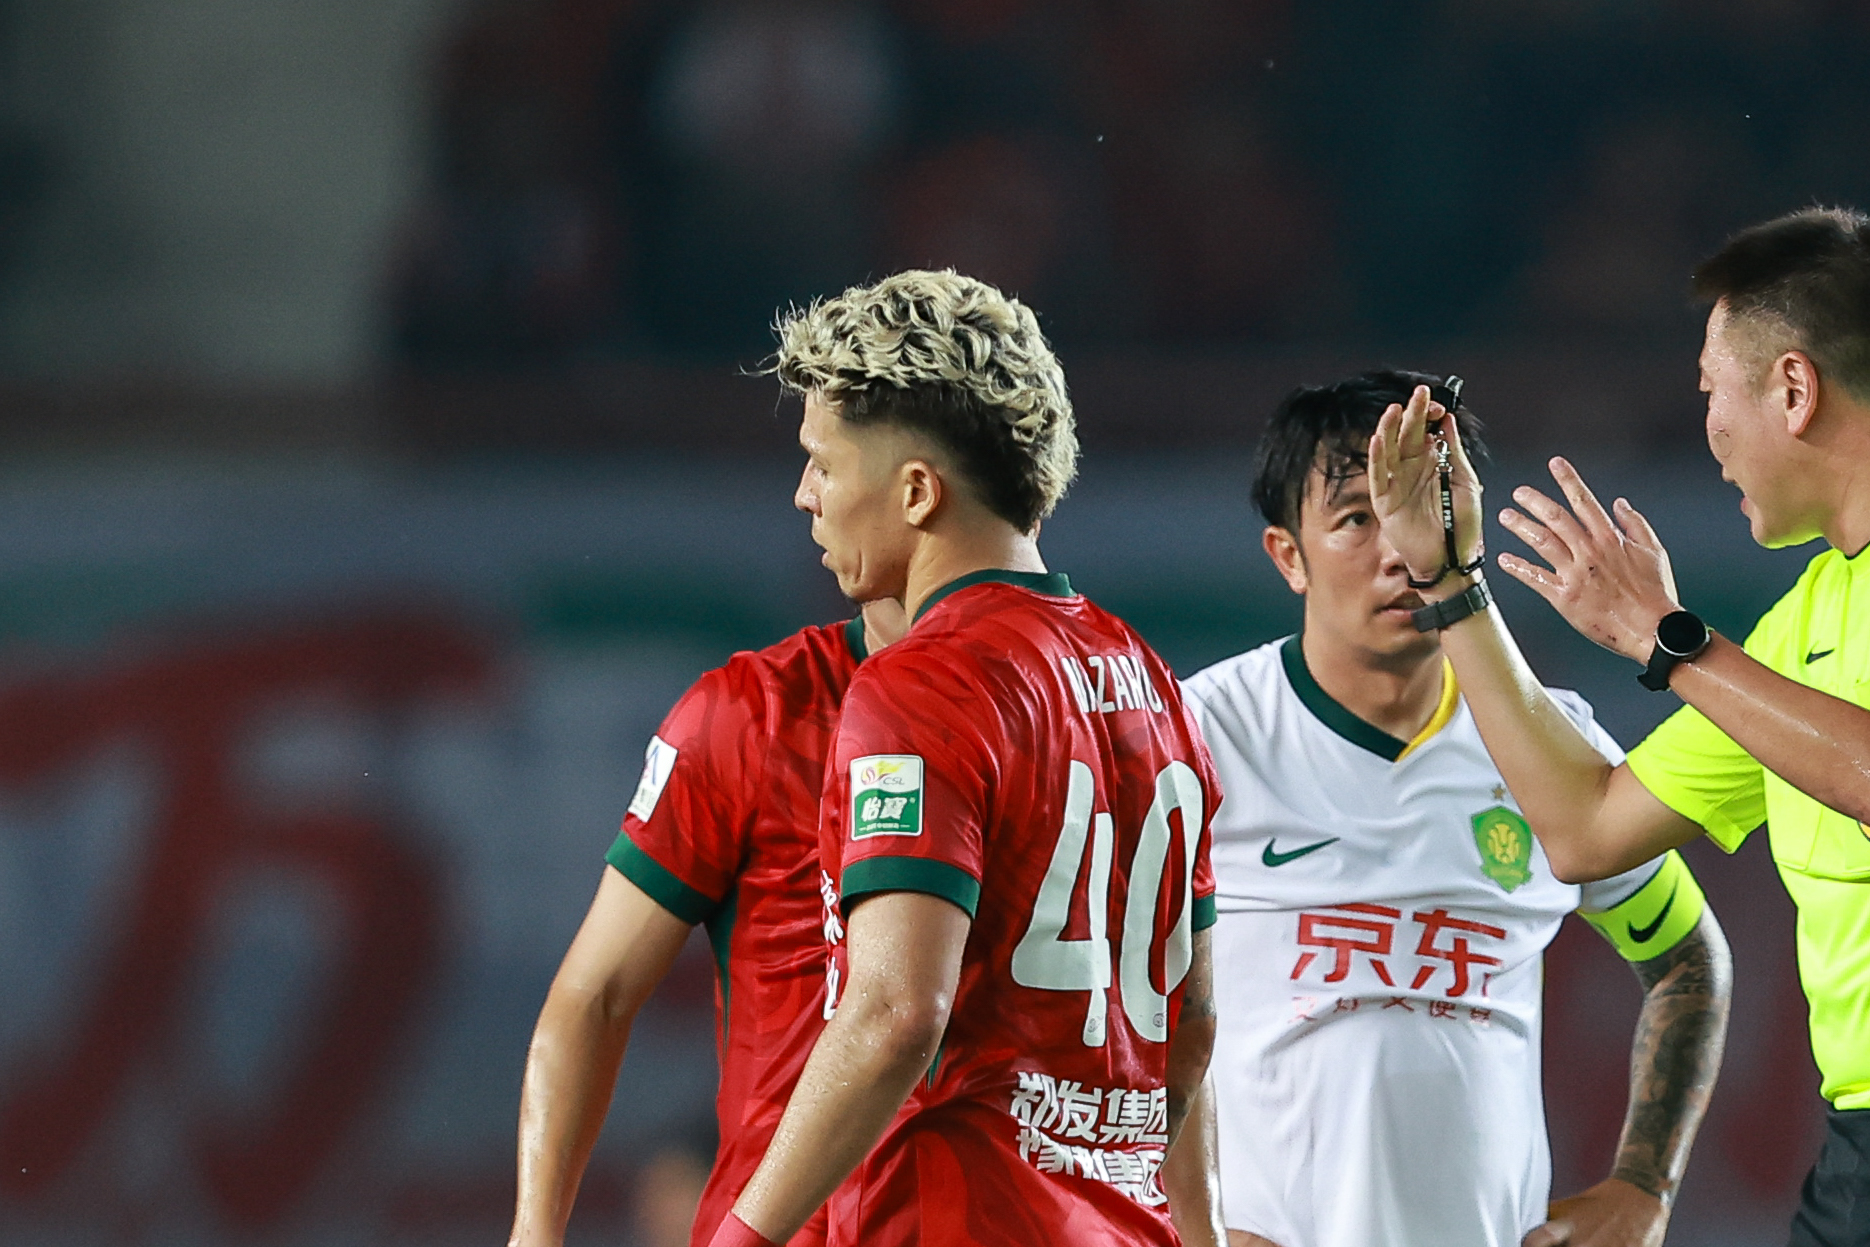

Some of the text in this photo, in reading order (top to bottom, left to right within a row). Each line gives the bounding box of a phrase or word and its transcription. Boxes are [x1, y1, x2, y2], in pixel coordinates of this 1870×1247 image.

[882, 776, 906, 786] CSL
[1011, 759, 1203, 1047] 40
[1289, 902, 1508, 998] 京东
